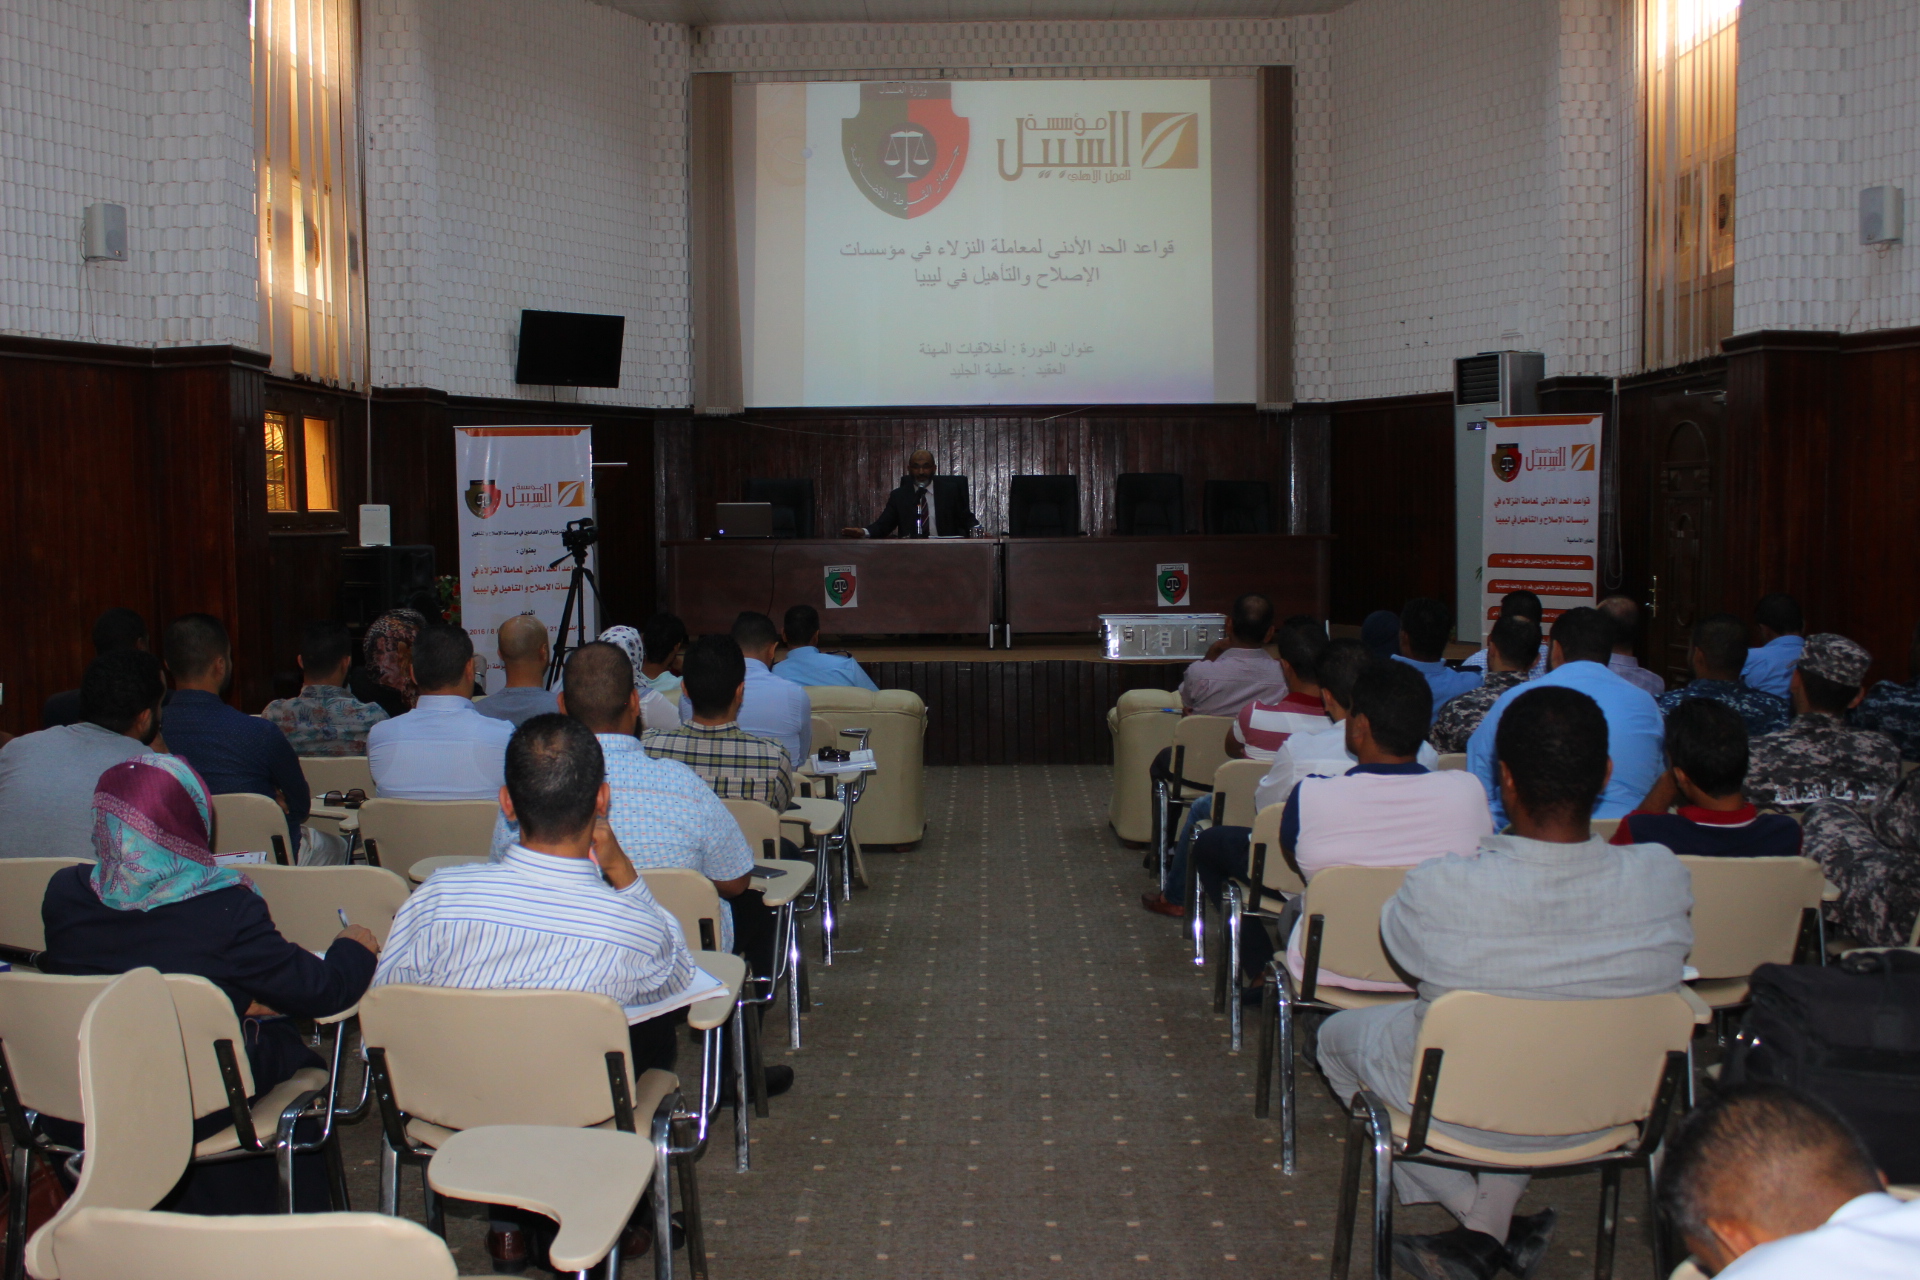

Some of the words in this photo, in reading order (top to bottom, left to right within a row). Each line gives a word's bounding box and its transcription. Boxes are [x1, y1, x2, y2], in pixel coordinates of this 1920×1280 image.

[1024, 113, 1107, 136] مؤسسة
[996, 110, 1131, 182] السبيل
[839, 242, 906, 260] مؤسسات
[910, 241, 931, 261] في
[938, 239, 985, 259] النزلاء
[991, 238, 1042, 254] لمعاملة
[1048, 236, 1091, 259] الأدنى
[1098, 238, 1126, 254] الحد
[1133, 240, 1175, 259] قواعد
[914, 268, 941, 286] ليبيا
[947, 270, 967, 289] في
[973, 264, 1031, 285] والتأهيل
[1036, 266, 1100, 288] الإصلاح
[919, 342, 952, 357] المهنة
[956, 339, 1006, 357] أخلاقيات
[1020, 341, 1056, 357] الدورة
[1060, 342, 1095, 357] عنوان
[505, 483, 552, 508] السبيل
[1573, 496, 1591, 506] قواعد
[525, 564, 545, 575] الأدنى
[499, 584, 524, 594] التأهيل
[529, 582, 554, 593] الإصلاح
